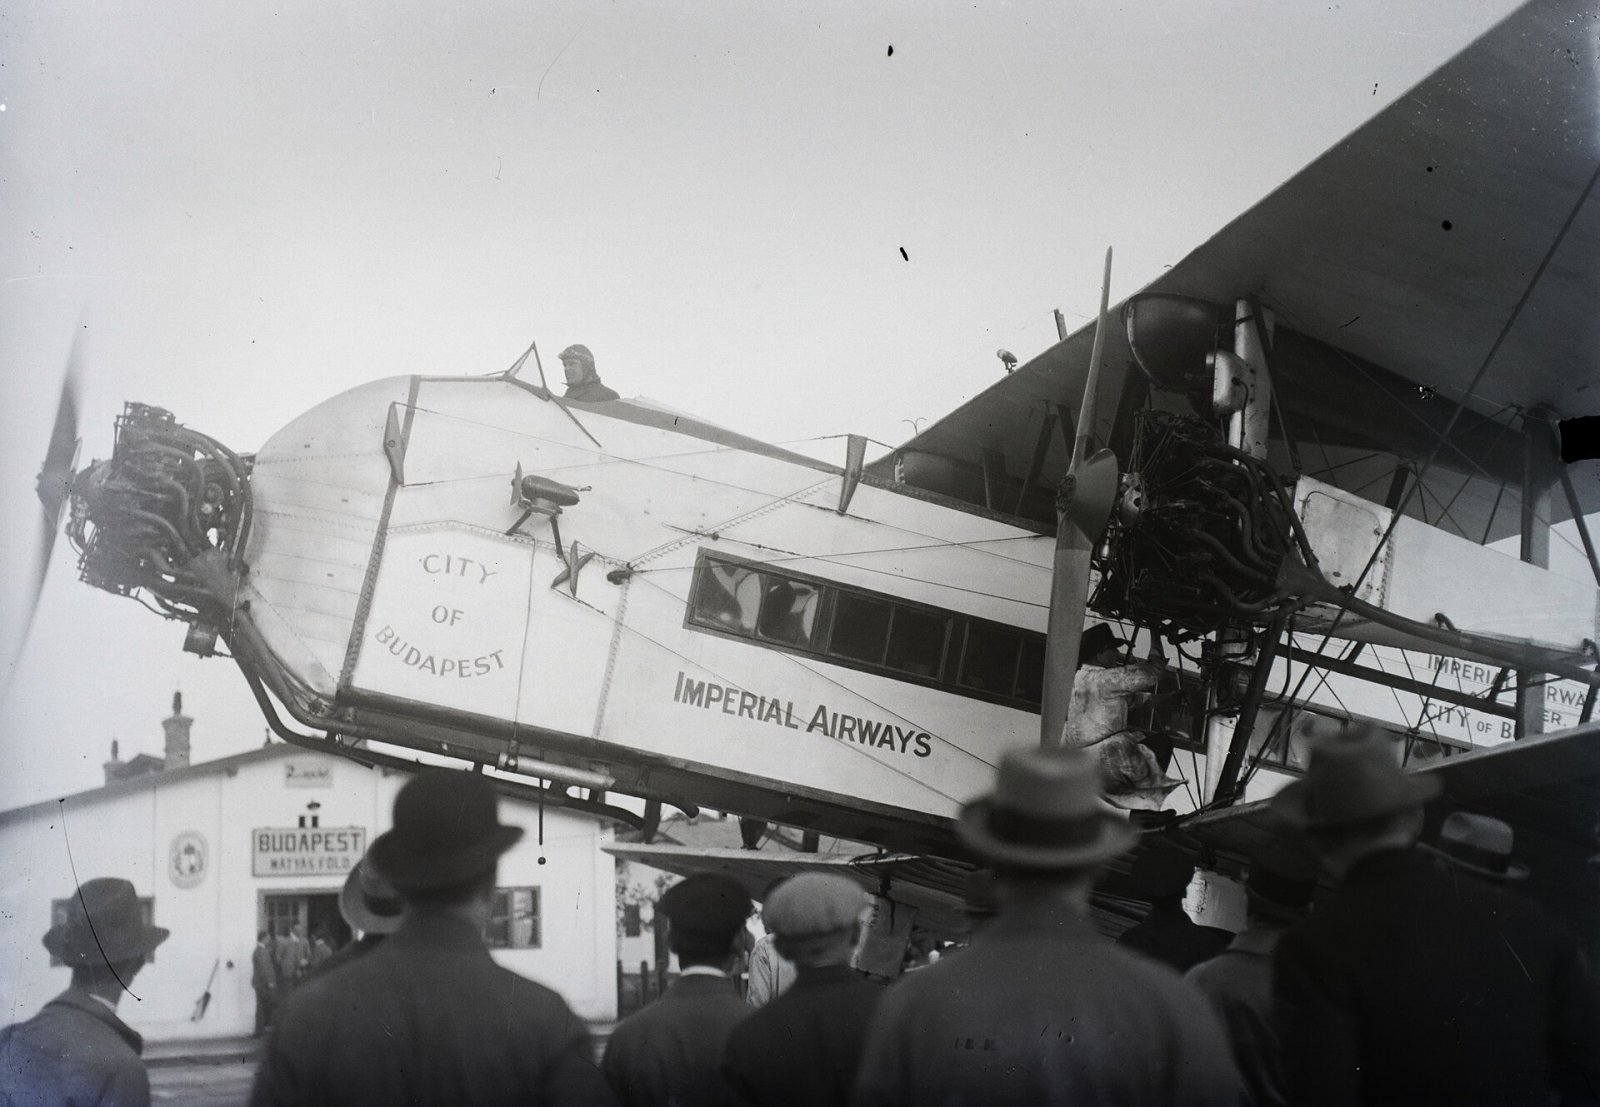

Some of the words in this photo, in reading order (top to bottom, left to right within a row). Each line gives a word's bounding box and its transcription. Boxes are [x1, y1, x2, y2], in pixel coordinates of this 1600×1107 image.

[423, 554, 498, 585] CITY
[431, 605, 464, 627] OF
[374, 624, 505, 678] BUDAPEST
[673, 671, 799, 730] IMPERIAL
[805, 704, 932, 758] AIRWAYS
[1426, 702, 1471, 728] CITY
[1476, 720, 1494, 734] OF
[258, 832, 361, 853] BUDAPEST
